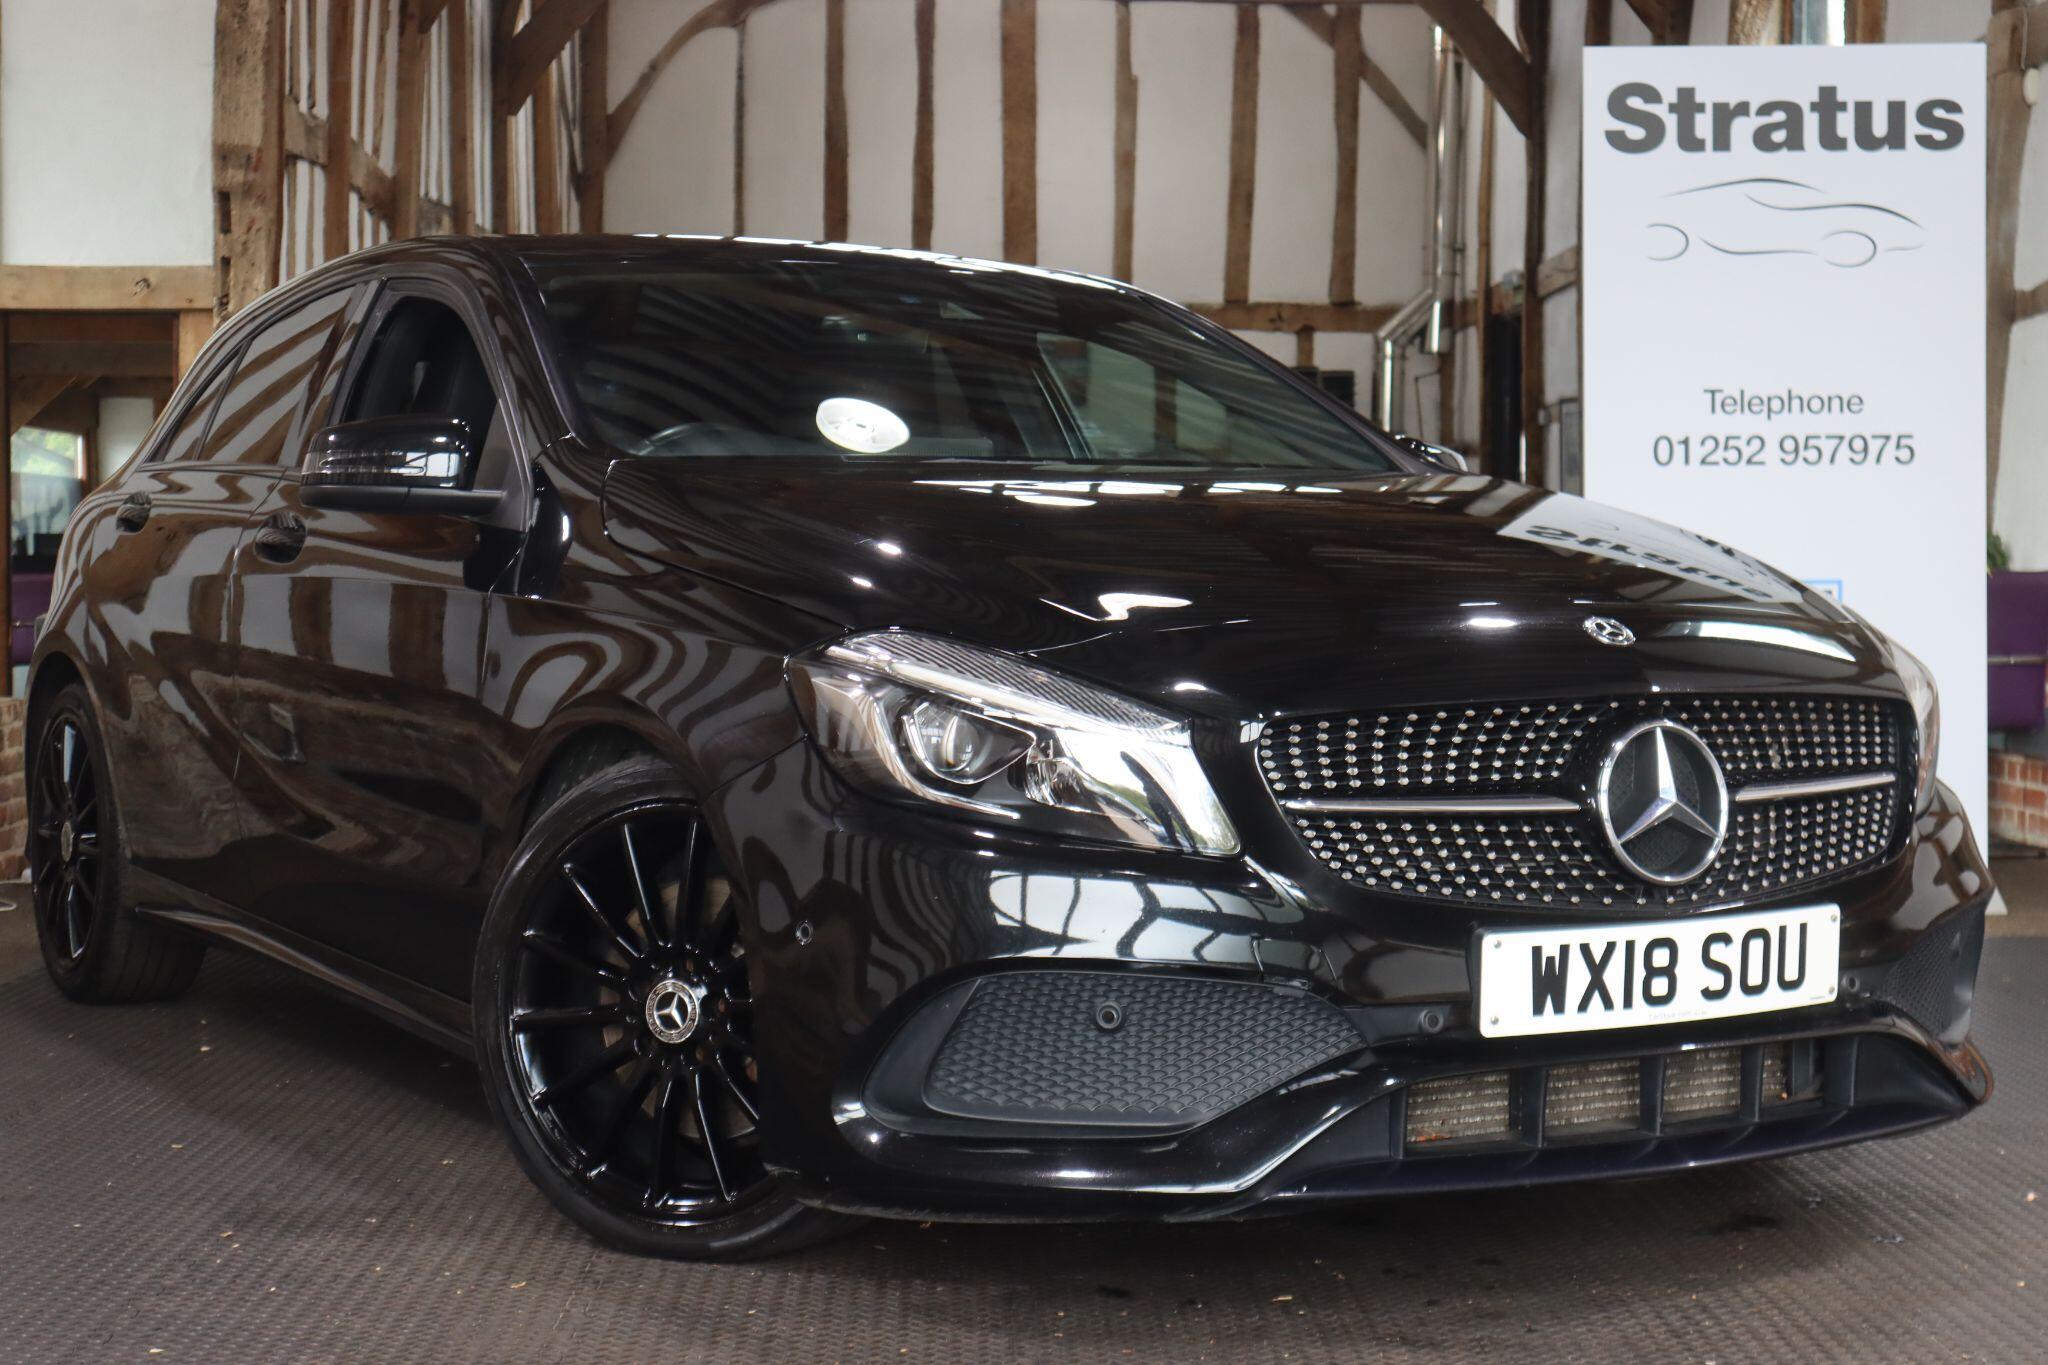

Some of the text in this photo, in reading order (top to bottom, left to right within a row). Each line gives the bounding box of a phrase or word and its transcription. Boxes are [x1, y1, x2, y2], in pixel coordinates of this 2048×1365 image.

[1604, 82, 1965, 155] Stratus
[1703, 388, 1865, 421] Telephone
[1653, 434, 1915, 467] 01252 957975
[1531, 922, 1808, 1017] WX18 SOU
